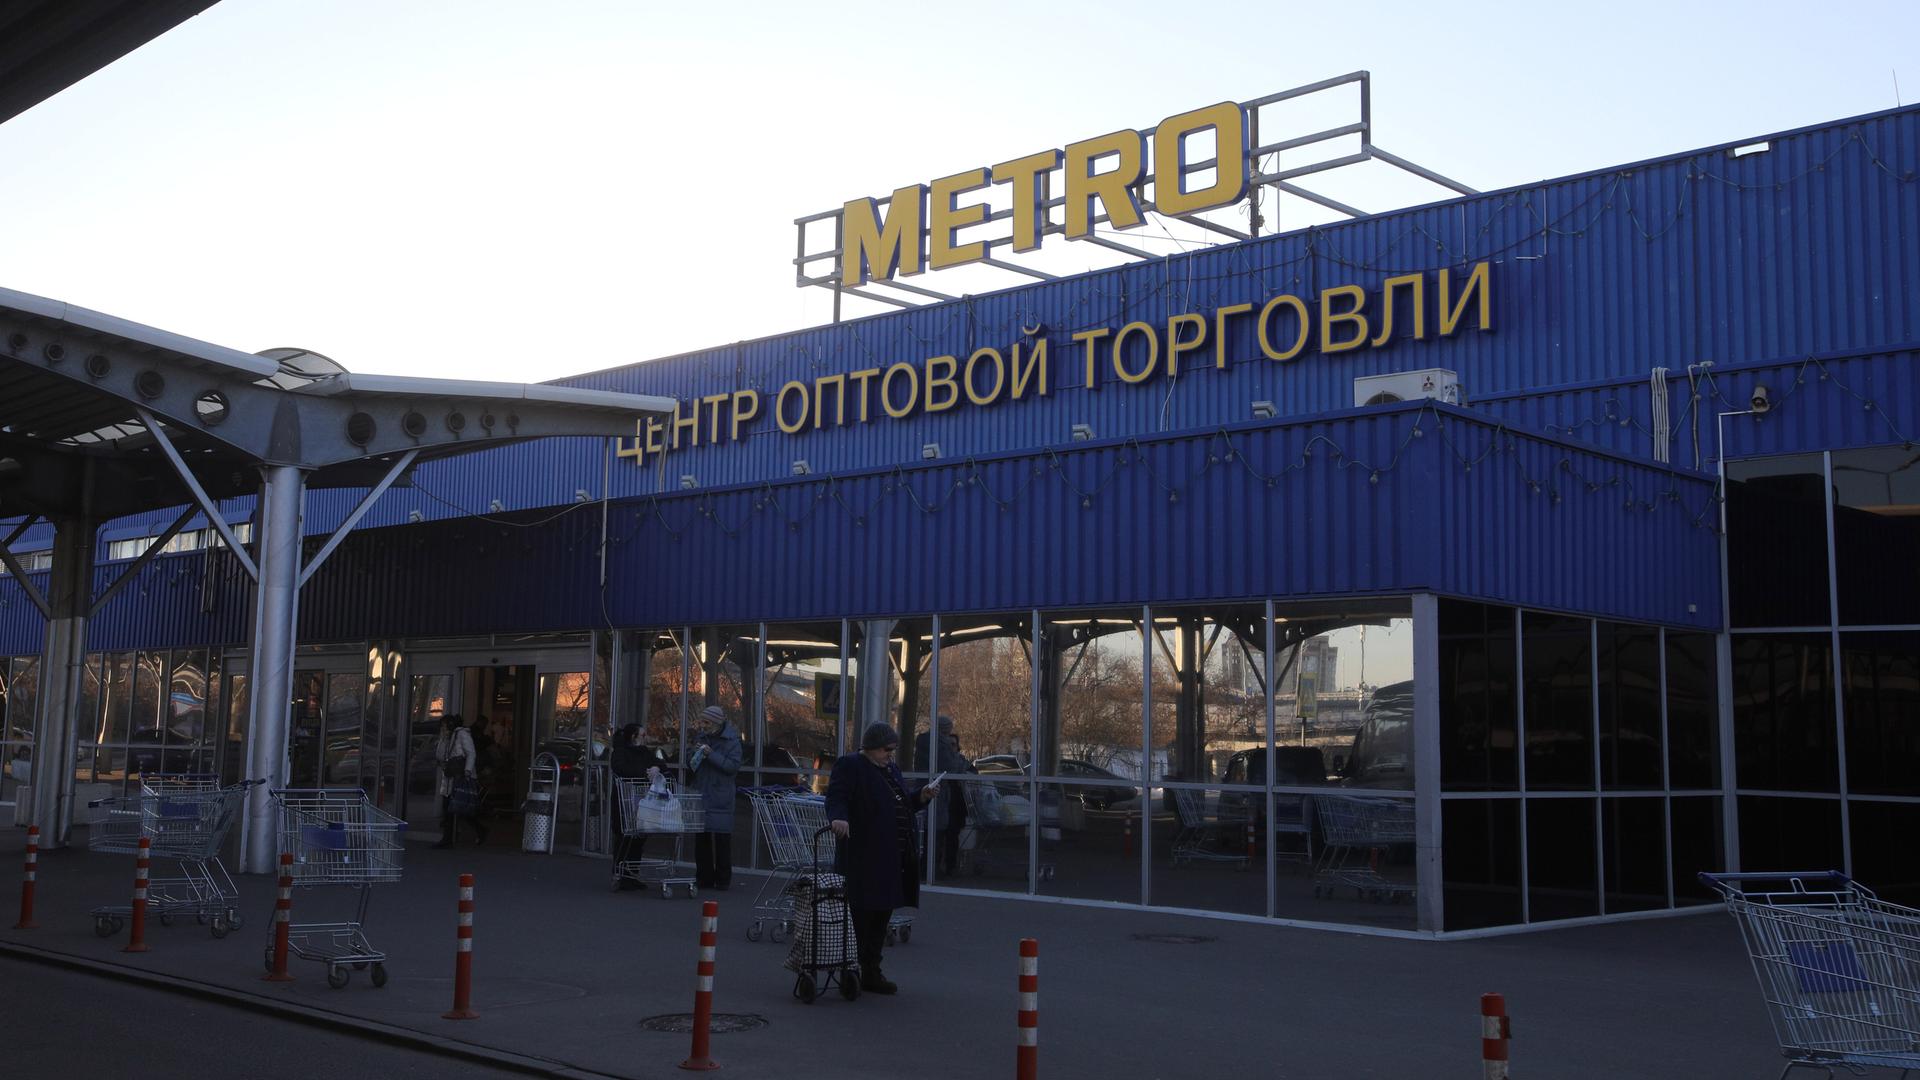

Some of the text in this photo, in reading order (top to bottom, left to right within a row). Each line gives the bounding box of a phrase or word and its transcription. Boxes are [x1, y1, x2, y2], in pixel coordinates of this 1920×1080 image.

[842, 101, 1249, 288] METRO
[776, 323, 1048, 433] ОПТОВОЙ
[1072, 262, 1490, 389] ТОРГОВЛИ
